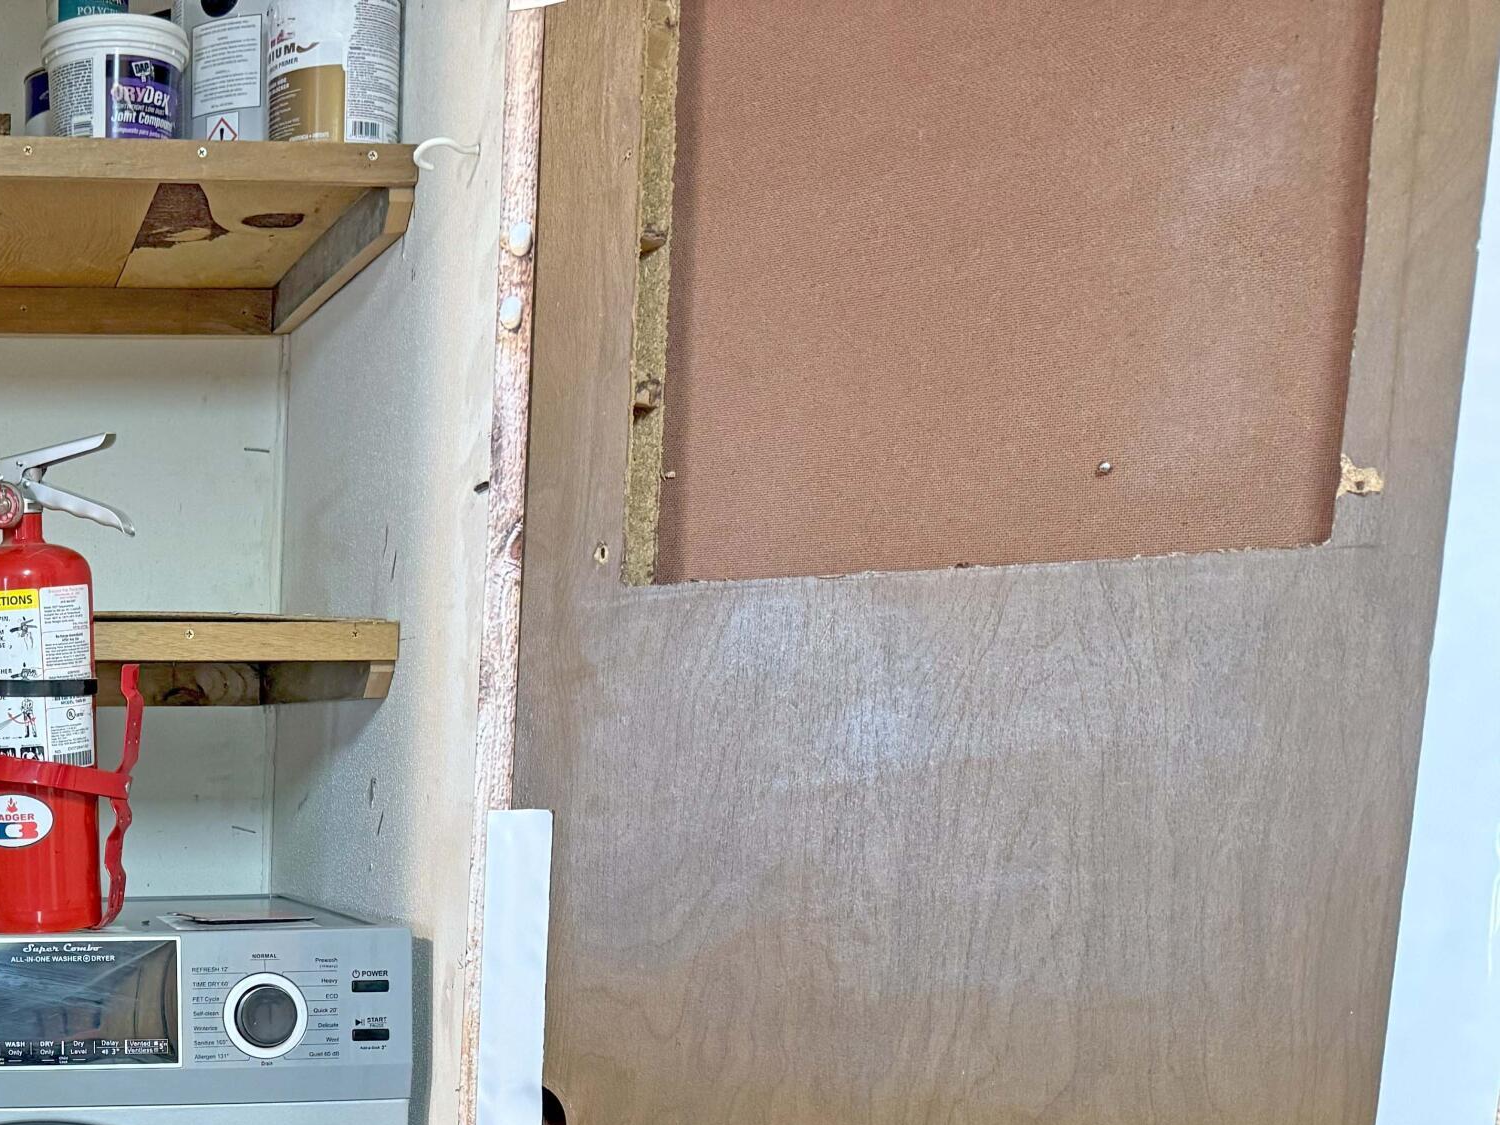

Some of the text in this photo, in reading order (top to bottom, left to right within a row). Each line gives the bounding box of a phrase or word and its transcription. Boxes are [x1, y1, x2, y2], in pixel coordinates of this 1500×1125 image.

[22, 943, 103, 954] Super Combo
[10, 955, 51, 963] ALL-IN-ONE
[91, 954, 115, 962] DRYER
[73, 1040, 84, 1048] Dry
